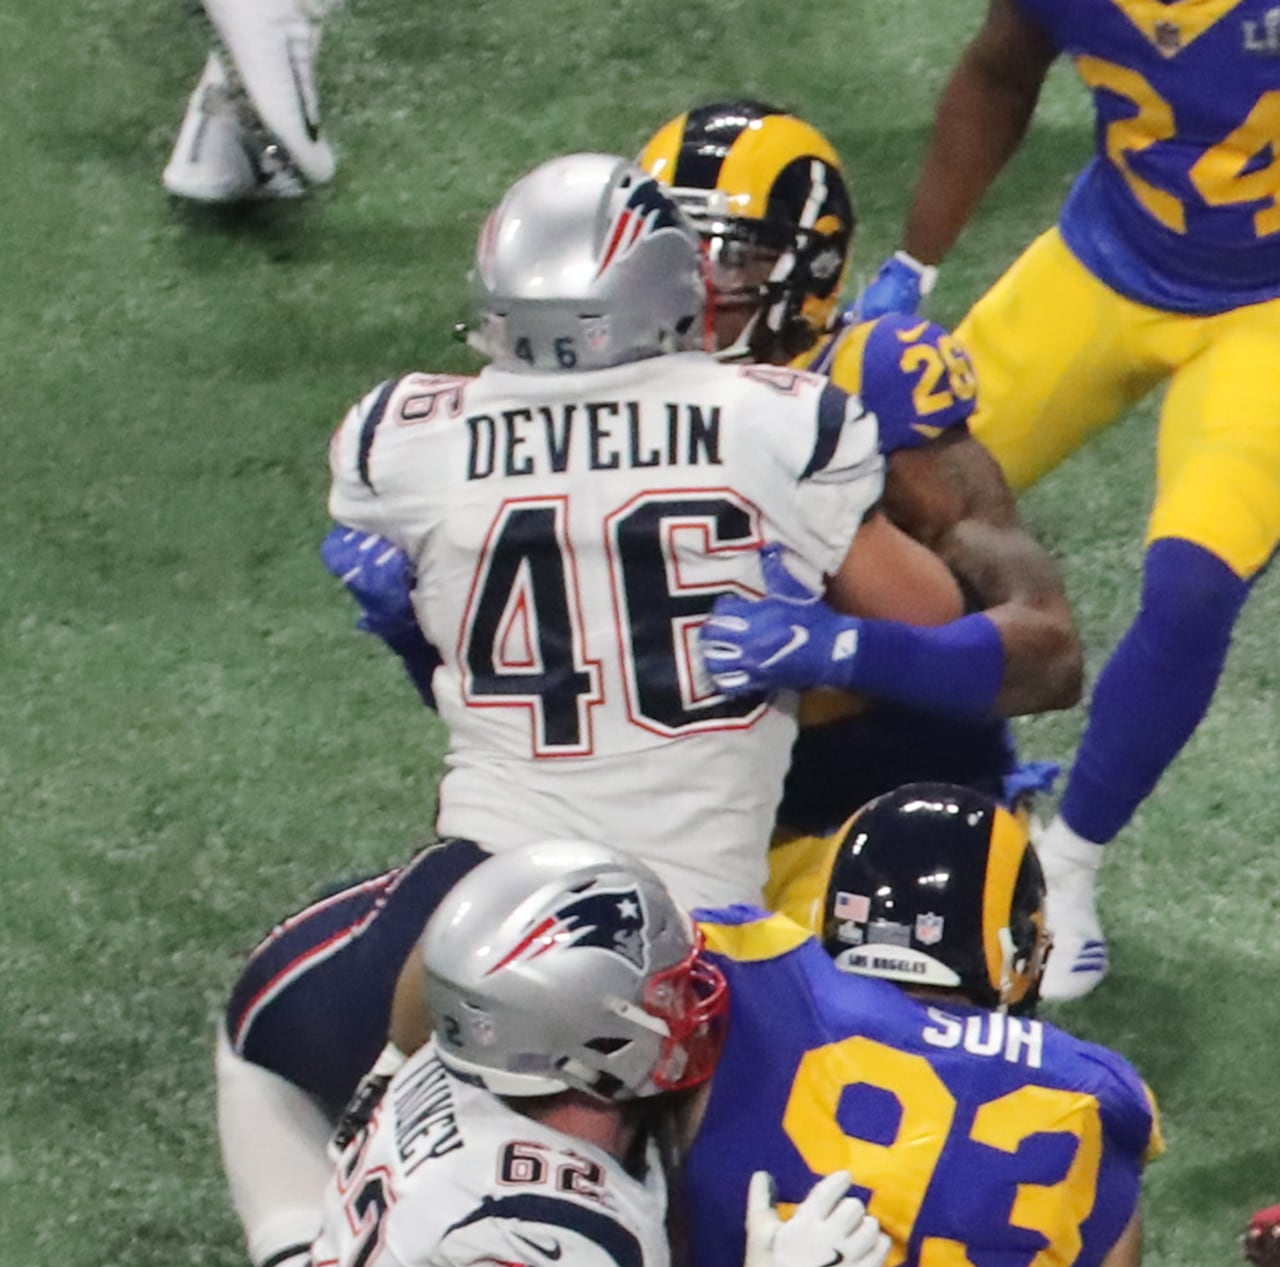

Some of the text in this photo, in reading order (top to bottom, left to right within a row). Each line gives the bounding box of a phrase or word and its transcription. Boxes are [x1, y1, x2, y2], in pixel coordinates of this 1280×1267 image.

[515, 336, 577, 369] 46
[466, 401, 724, 481] DEVELIN
[457, 486, 772, 759] 46
[921, 1006, 1044, 1068] SUH
[495, 1139, 608, 1207] 62
